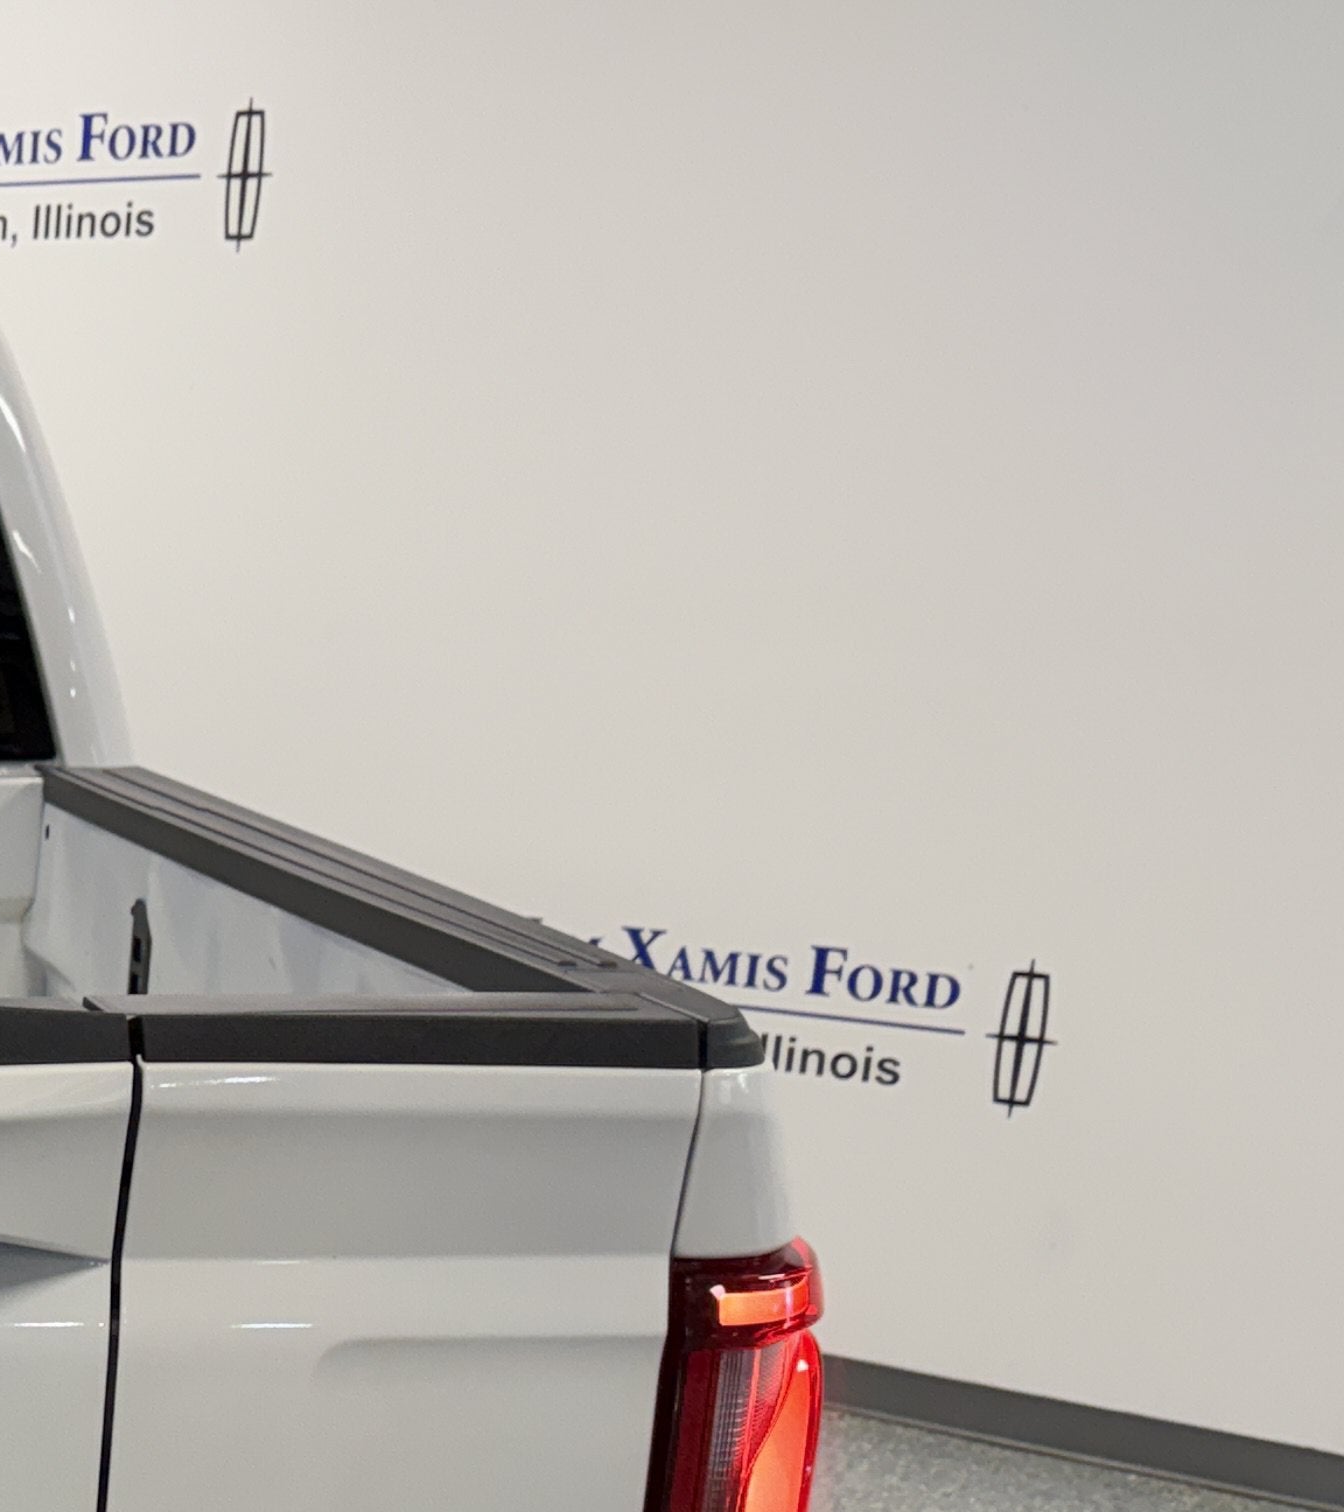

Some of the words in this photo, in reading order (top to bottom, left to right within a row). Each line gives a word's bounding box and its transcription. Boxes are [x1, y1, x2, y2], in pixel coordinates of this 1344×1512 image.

[78, 112, 197, 161] FORD
[32, 201, 155, 239] Illinois
[805, 945, 962, 1011] FORD
